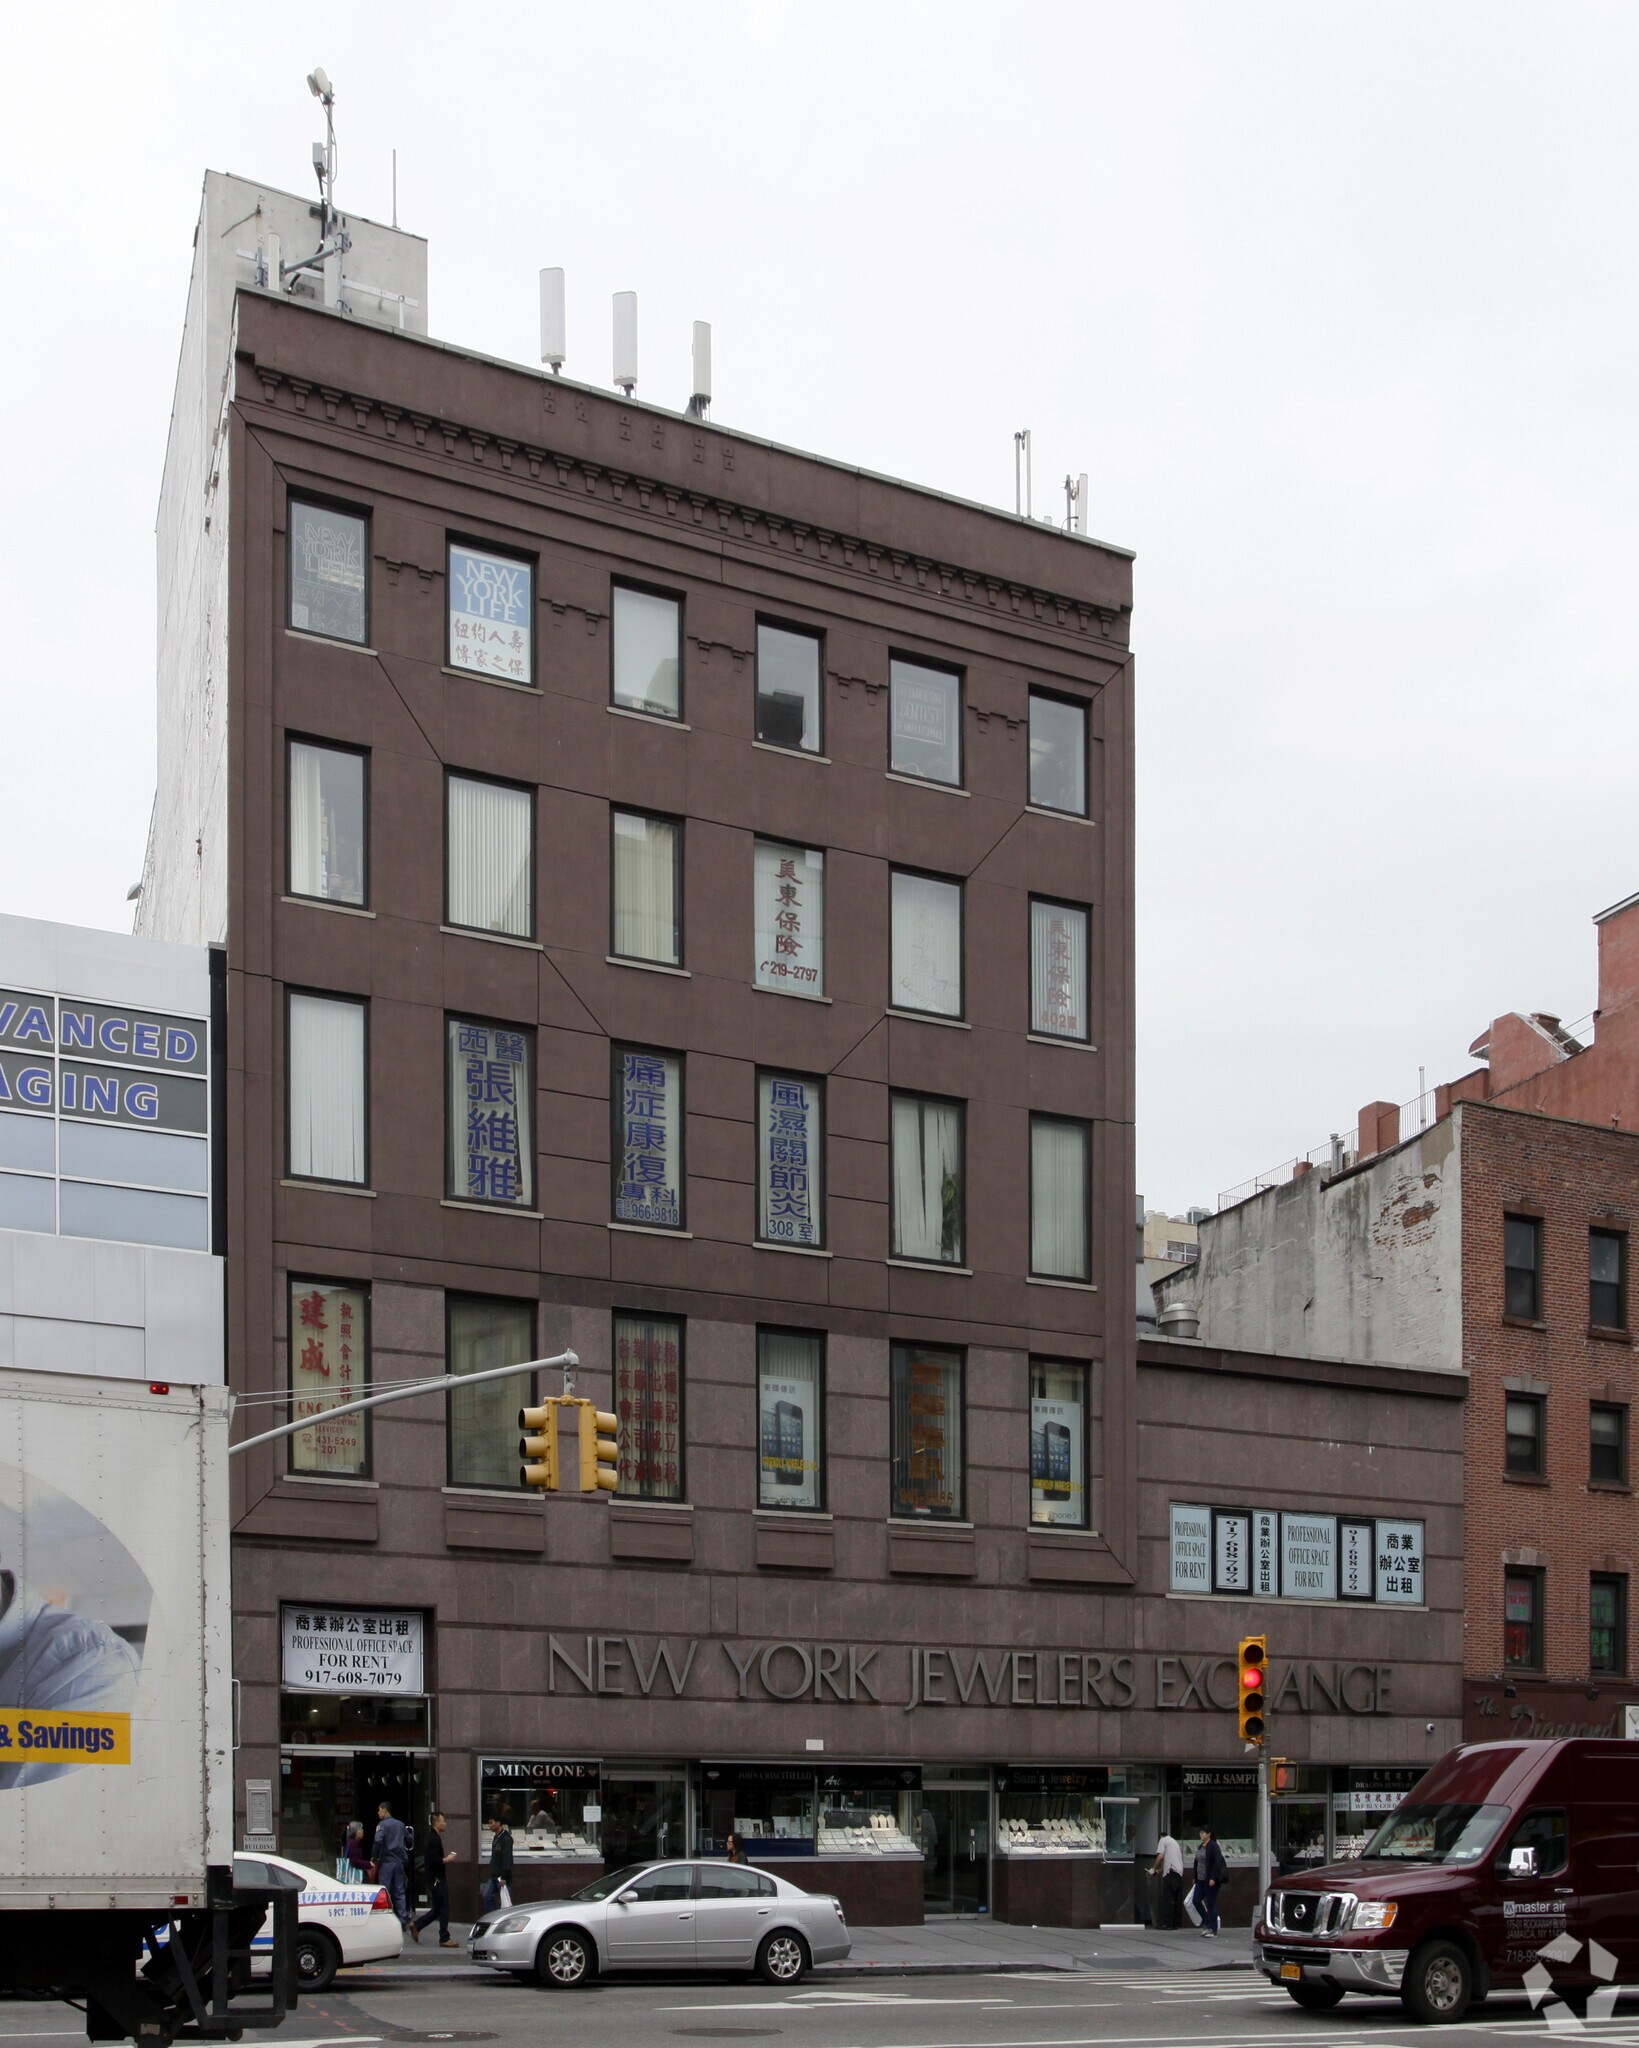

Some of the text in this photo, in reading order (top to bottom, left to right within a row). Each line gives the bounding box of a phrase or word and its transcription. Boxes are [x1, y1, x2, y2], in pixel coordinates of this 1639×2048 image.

[466, 559, 519, 586] NEW
[456, 574, 524, 609] YORK
[466, 594, 517, 623] LIFE
[769, 961, 818, 983] 219-2797
[316, 1435, 357, 1447] 431-5249
[321, 1444, 337, 1455] 201
[1174, 1520, 1208, 1538] PROFESSIONAL
[1287, 1525, 1331, 1544] PROFESSIONAL
[1175, 1541, 1206, 1558] OFFICE SPACE
[1386, 1533, 1414, 1551] 商業
[1288, 1547, 1330, 1567] OFFICE SPACE
[1175, 1561, 1206, 1579] FOR RENT
[1294, 1570, 1323, 1588] FOR RENT
[1386, 1576, 1413, 1594] 出租
[295, 1614, 409, 1636] 商業辦公室出租
[292, 1635, 414, 1654] PROFESSIONAL OFFICE SPACE
[319, 1653, 390, 1669] FOR RENT
[304, 1669, 402, 1686] 917-608-7079
[548, 1633, 1394, 1714] NEW YORK JEWELERS EXCANGE
[18, 1720, 115, 1754] Savings
[498, 1764, 585, 1777] MINGIONE
[1183, 1773, 1212, 1784] JOHN
[1515, 1901, 1550, 1913] master
[1552, 1900, 1567, 1913] air
